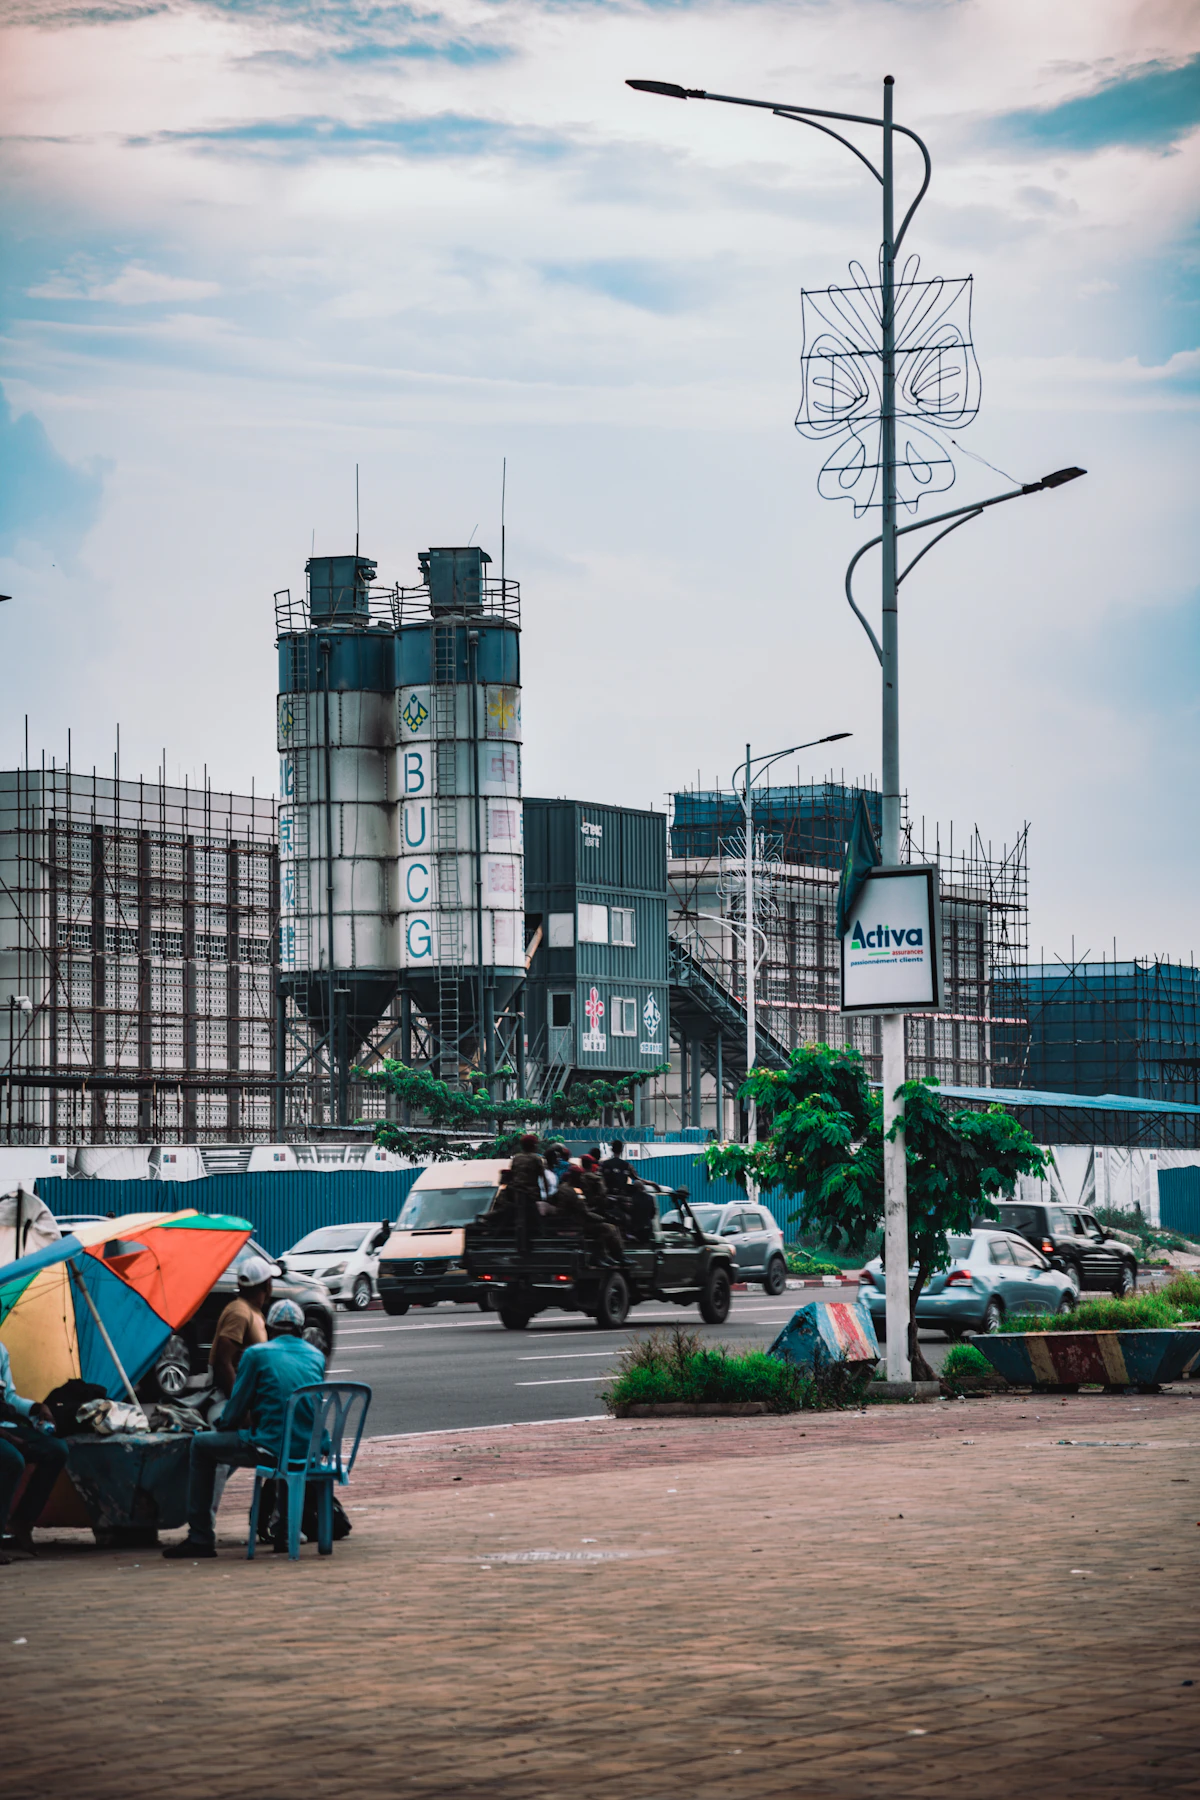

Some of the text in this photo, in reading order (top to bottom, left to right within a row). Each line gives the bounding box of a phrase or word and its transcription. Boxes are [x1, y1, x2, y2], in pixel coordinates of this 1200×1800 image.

[404, 752, 432, 959] BUCG
[851, 920, 923, 949] Activa
[850, 958, 898, 967] passionnément
